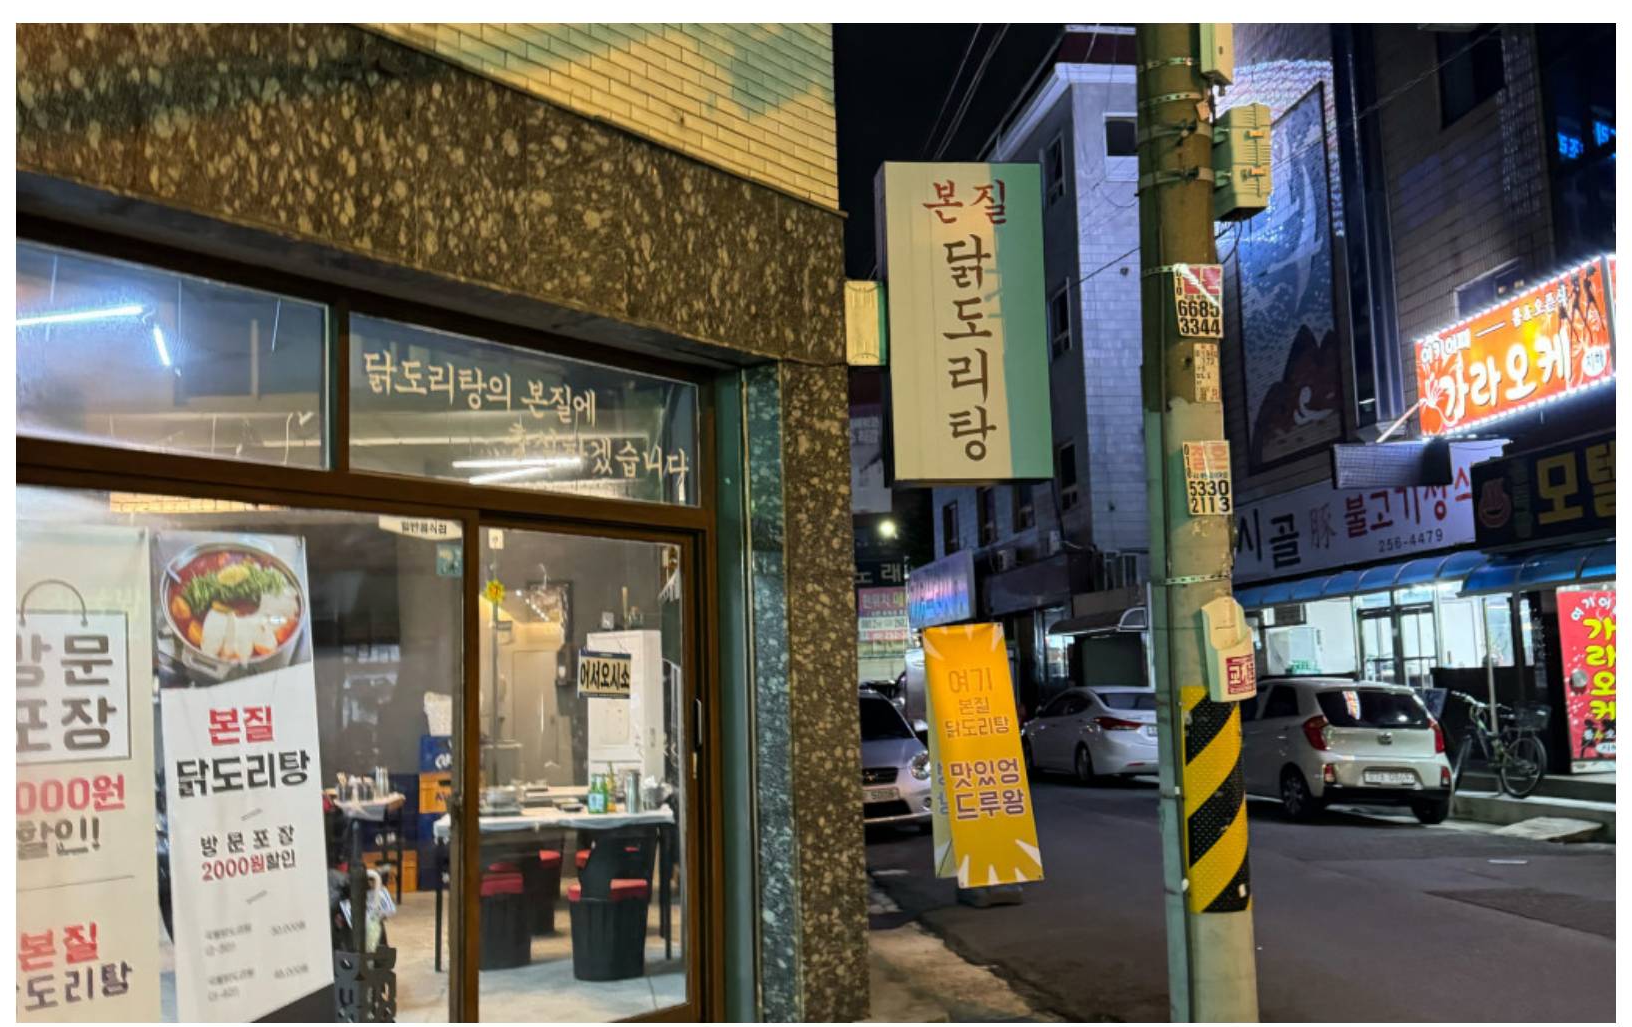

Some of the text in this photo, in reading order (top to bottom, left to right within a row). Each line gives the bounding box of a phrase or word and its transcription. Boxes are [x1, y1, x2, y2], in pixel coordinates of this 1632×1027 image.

[1180, 317, 1221, 335] 3344
[943, 234, 998, 462] 닭도리탕
[364, 350, 595, 430] 닭도리탕의 본질에
[1438, 331, 1572, 420] 가라오케
[1190, 480, 1229, 497] 5330
[1191, 496, 1230, 513] 2113
[1233, 508, 1302, 570] 시골
[1378, 527, 1443, 553] 256-4479
[948, 667, 993, 695] 여기
[958, 697, 991, 717] 본질
[208, 705, 275, 747] 본질
[944, 717, 1010, 741] 닭도리탕
[176, 750, 311, 799] 닭도리탕
[949, 757, 1020, 791] 맛있엉
[955, 790, 1026, 821] 드루왕
[17, 922, 101, 973] 본질
[16, 960, 135, 1014] 도리탕
